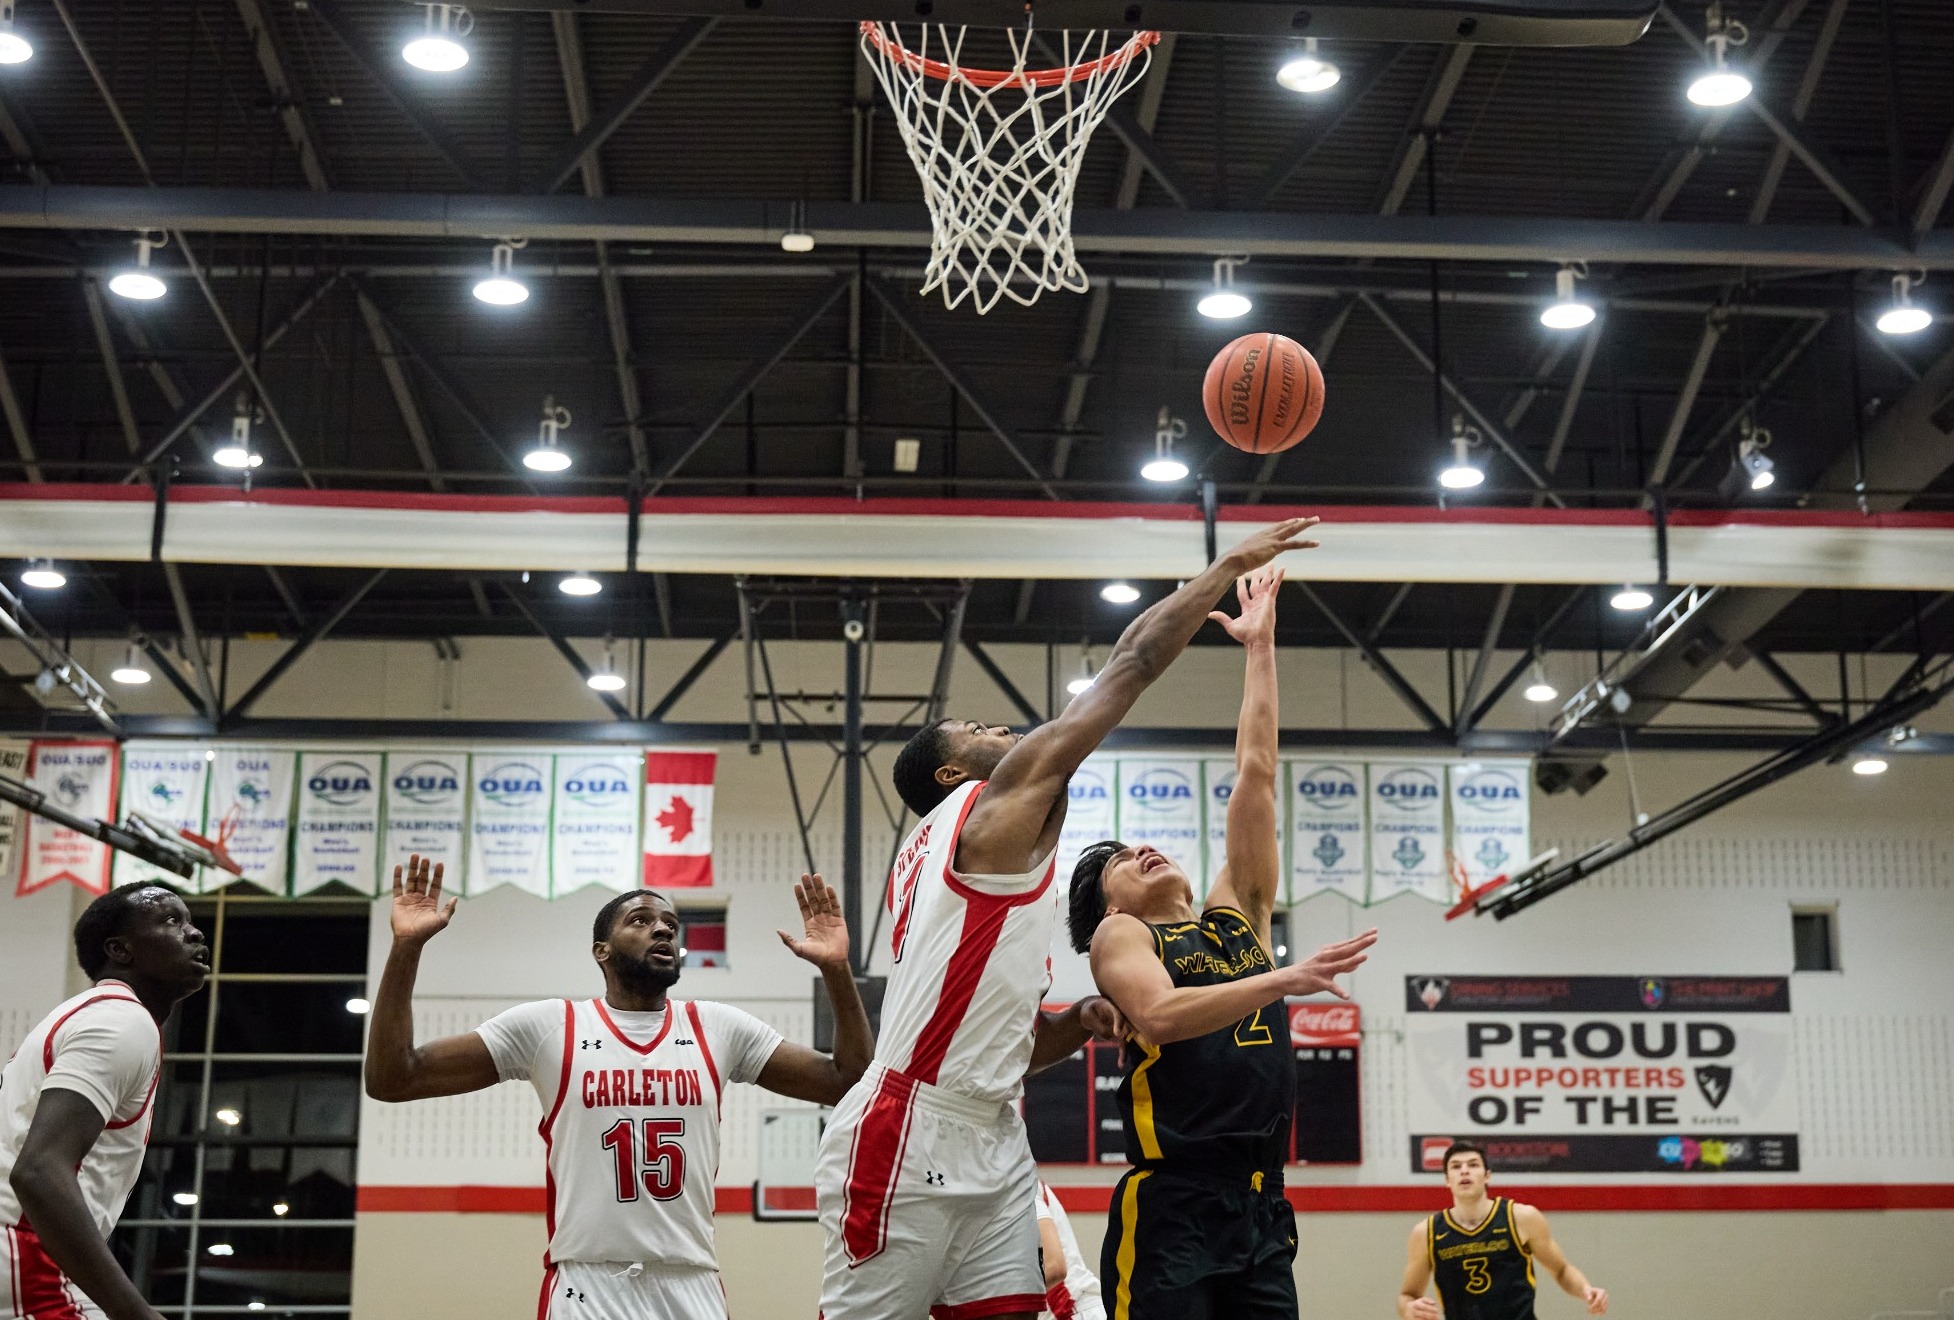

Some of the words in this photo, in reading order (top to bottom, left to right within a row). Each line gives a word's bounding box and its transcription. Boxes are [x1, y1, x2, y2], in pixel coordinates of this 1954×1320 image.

[1231, 349, 1261, 425] Wilson
[309, 777, 372, 791] OUA
[394, 777, 458, 791] OUA
[480, 778, 543, 792] OUA
[565, 780, 629, 793] OUA
[1129, 784, 1191, 798] OUA
[1299, 782, 1357, 797] OUA
[1377, 783, 1438, 798] OUA
[1458, 785, 1520, 799] OUA
[1234, 1008, 1273, 1047] 2
[1467, 1021, 1736, 1060] PROUD
[1467, 1066, 1686, 1089] SUPPORTERS
[582, 1068, 703, 1109] CARLETON
[1468, 1096, 1544, 1126] OF
[1565, 1096, 1679, 1125] THE
[601, 1118, 687, 1203] 15
[1463, 1256, 1492, 1294] 3
